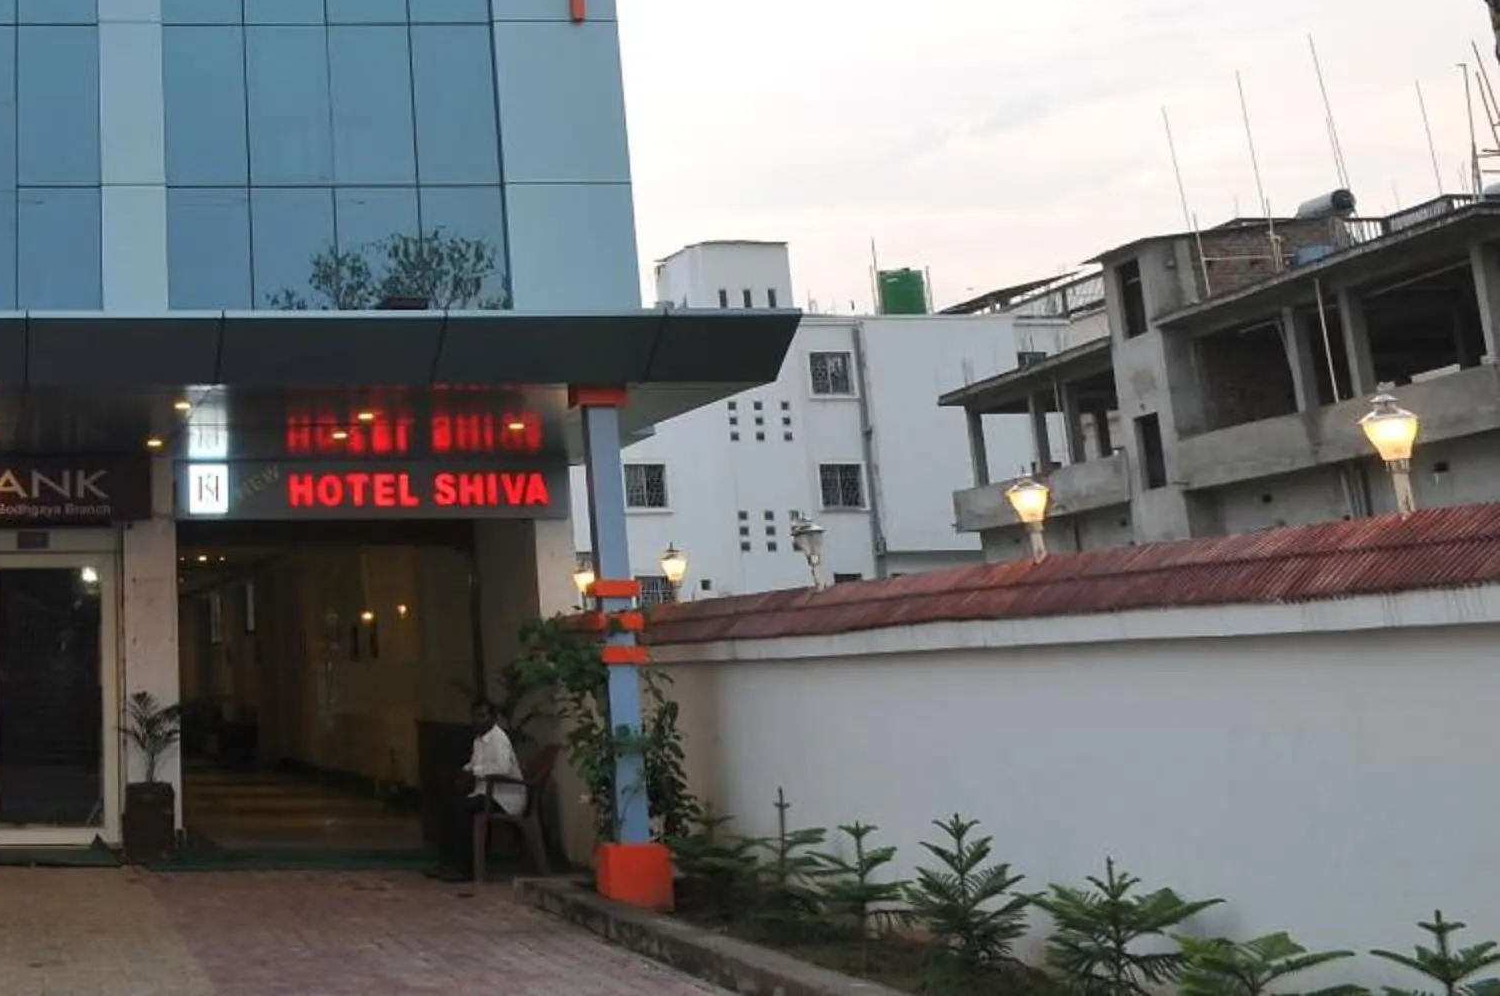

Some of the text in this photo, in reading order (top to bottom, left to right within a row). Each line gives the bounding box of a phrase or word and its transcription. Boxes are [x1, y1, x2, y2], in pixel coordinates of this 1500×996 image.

[288, 473, 419, 507] HOTEL
[434, 472, 549, 506] SHIVA
[66, 503, 112, 515] Branch
